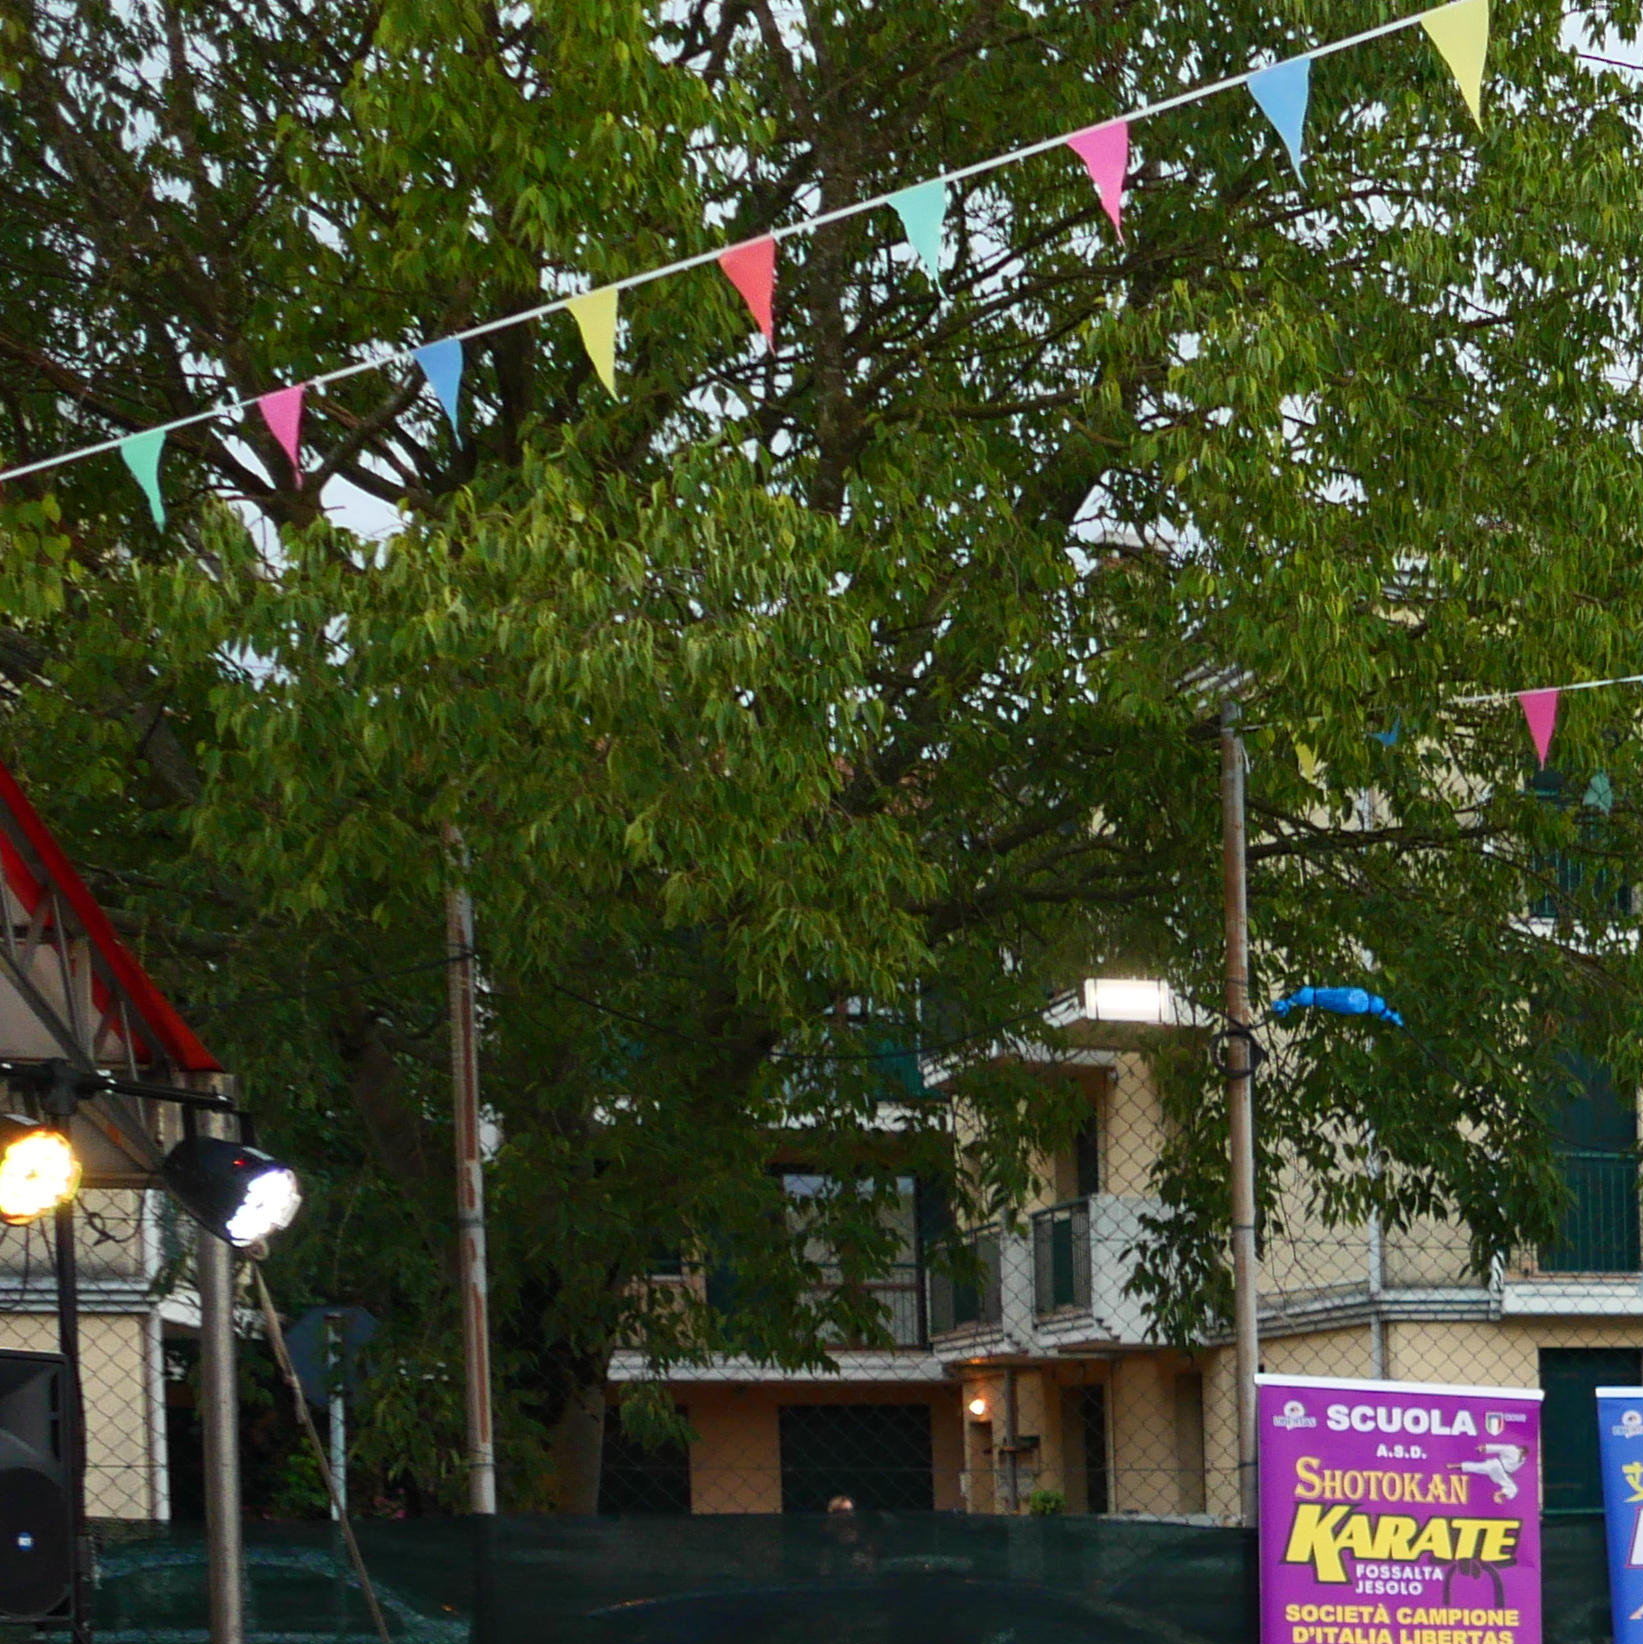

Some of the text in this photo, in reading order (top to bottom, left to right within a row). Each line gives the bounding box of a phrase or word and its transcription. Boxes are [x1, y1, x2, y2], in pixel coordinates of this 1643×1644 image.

[1326, 1404, 1477, 1437] SCUOLA
[1376, 1444, 1427, 1460] A.S.D.
[1294, 1456, 1470, 1505] SHOTOKAN
[1285, 1503, 1521, 1583] KARATE
[1356, 1564, 1444, 1581] FOSSALTA
[1355, 1580, 1423, 1595] JESOLO
[1285, 1603, 1520, 1627] SOCIETÀ CAMPIONE
